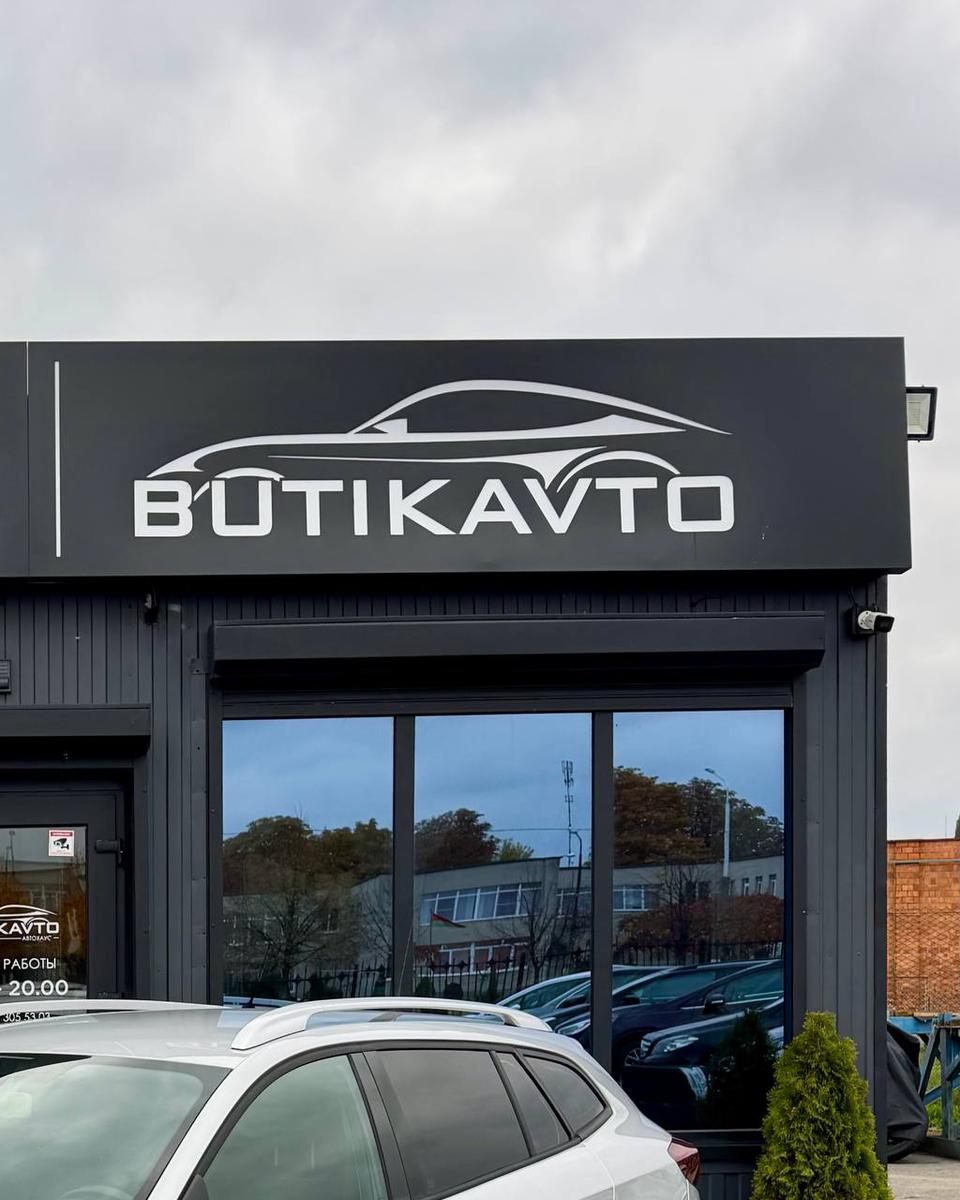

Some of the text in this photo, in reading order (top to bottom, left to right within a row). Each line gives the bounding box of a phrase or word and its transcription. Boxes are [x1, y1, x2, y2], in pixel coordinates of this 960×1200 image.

[133, 475, 734, 538] BUTIKAVTO
[3, 957, 57, 970] РАБОТЫ
[9, 979, 69, 996] 20.00
